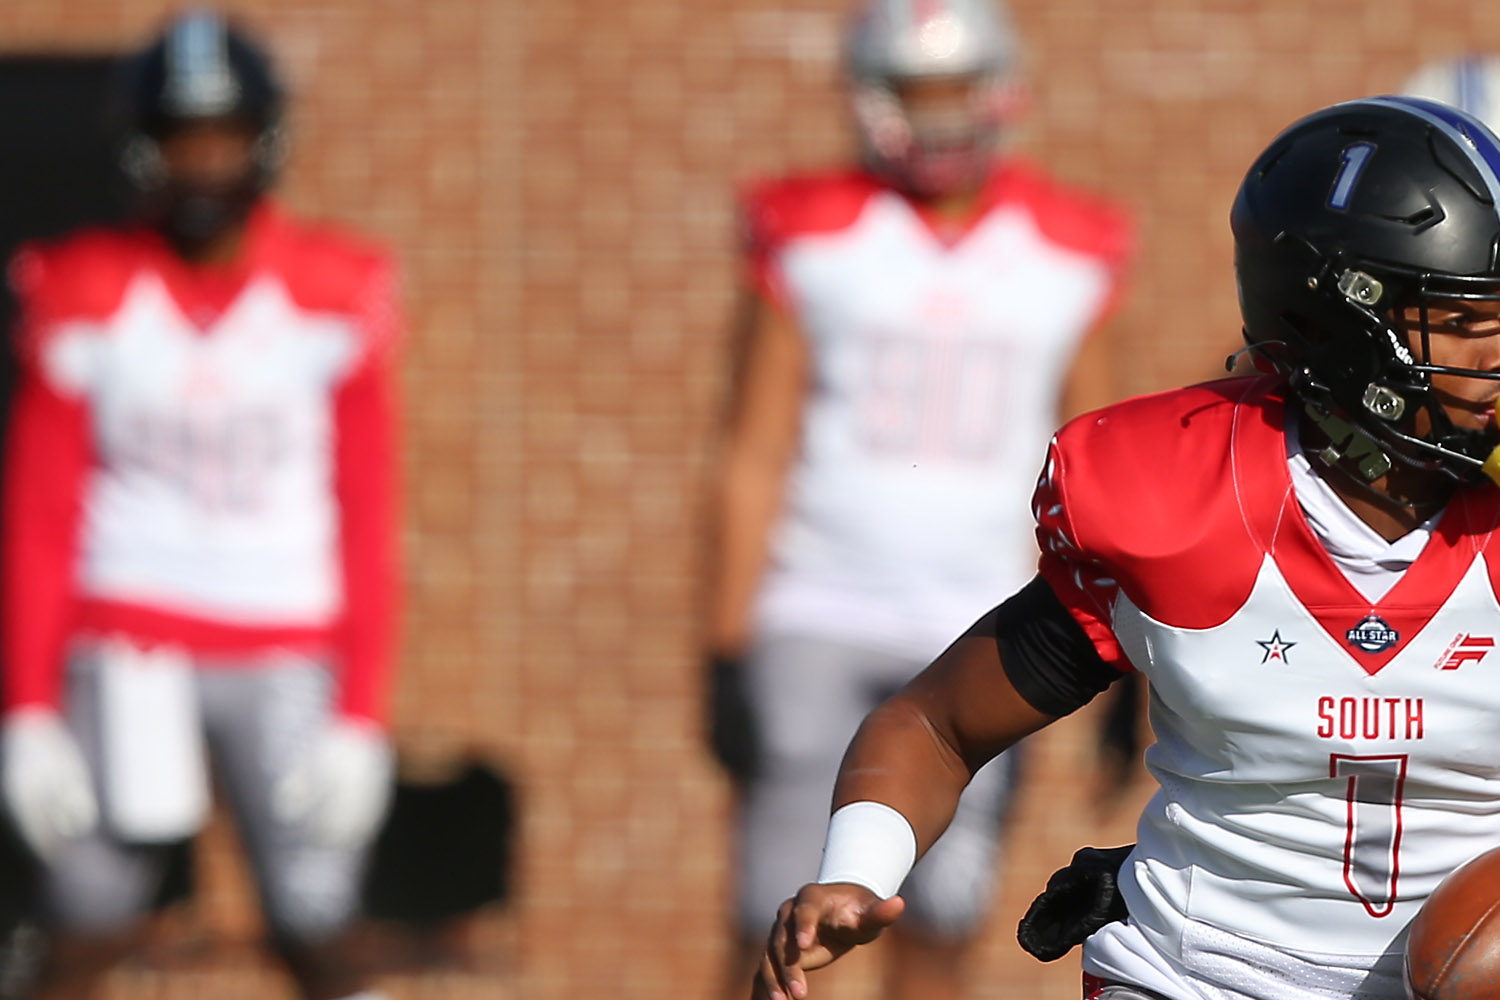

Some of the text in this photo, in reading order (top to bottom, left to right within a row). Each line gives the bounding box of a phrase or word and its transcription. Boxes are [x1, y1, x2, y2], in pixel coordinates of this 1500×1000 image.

[1328, 144, 1376, 209] 1
[1369, 630, 1397, 641] STAR
[1317, 696, 1424, 740] SOUTH
